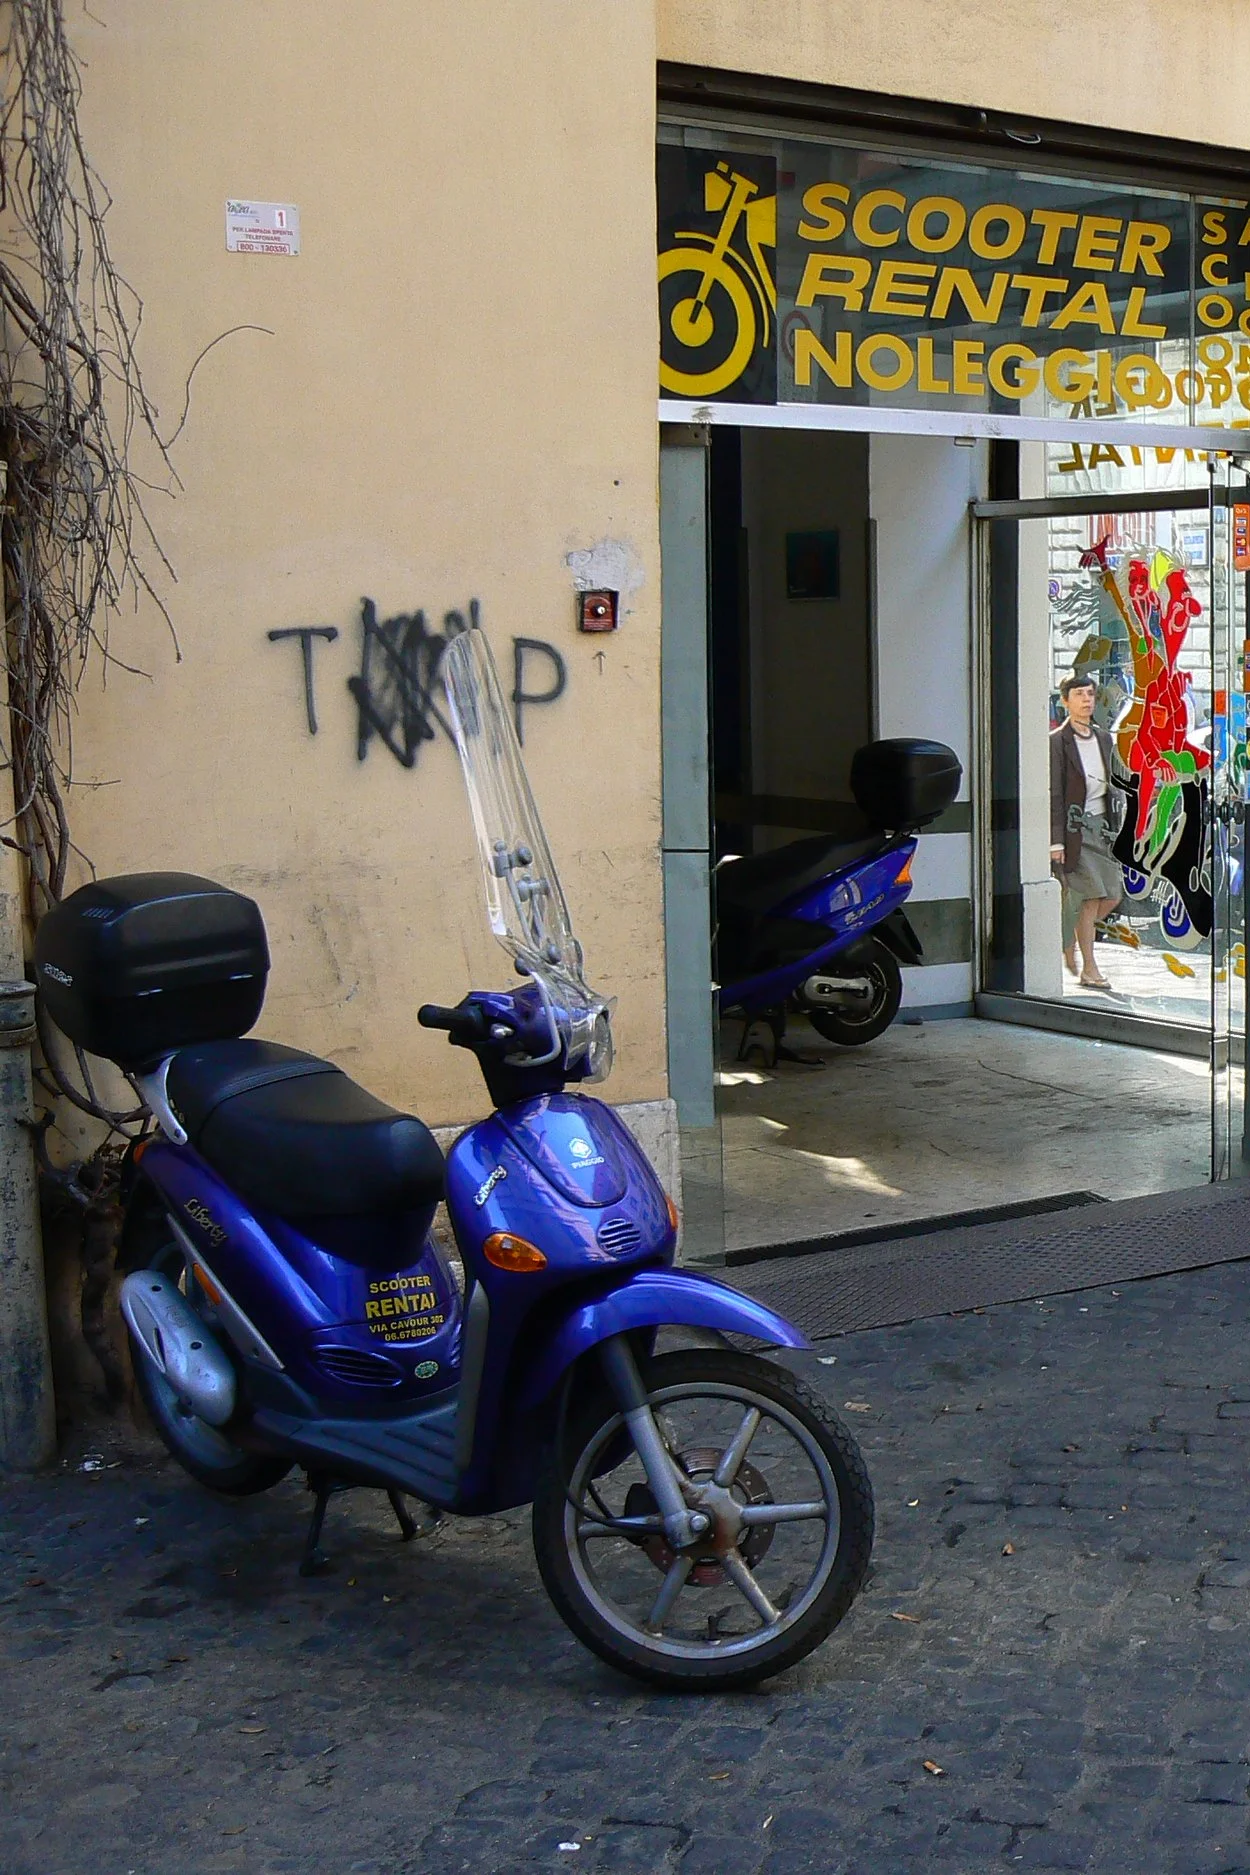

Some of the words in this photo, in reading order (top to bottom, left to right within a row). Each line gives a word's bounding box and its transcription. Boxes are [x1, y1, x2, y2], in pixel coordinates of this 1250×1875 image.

[798, 181, 1171, 277] SCOOTER
[795, 253, 1168, 339] RENTAL
[794, 329, 1164, 404] NOLEGGIO
[184, 1198, 227, 1248] Liberty
[369, 1275, 431, 1294] SCOOTER
[369, 1324, 388, 1333] VIA
[390, 1317, 429, 1330] CAVOUR
